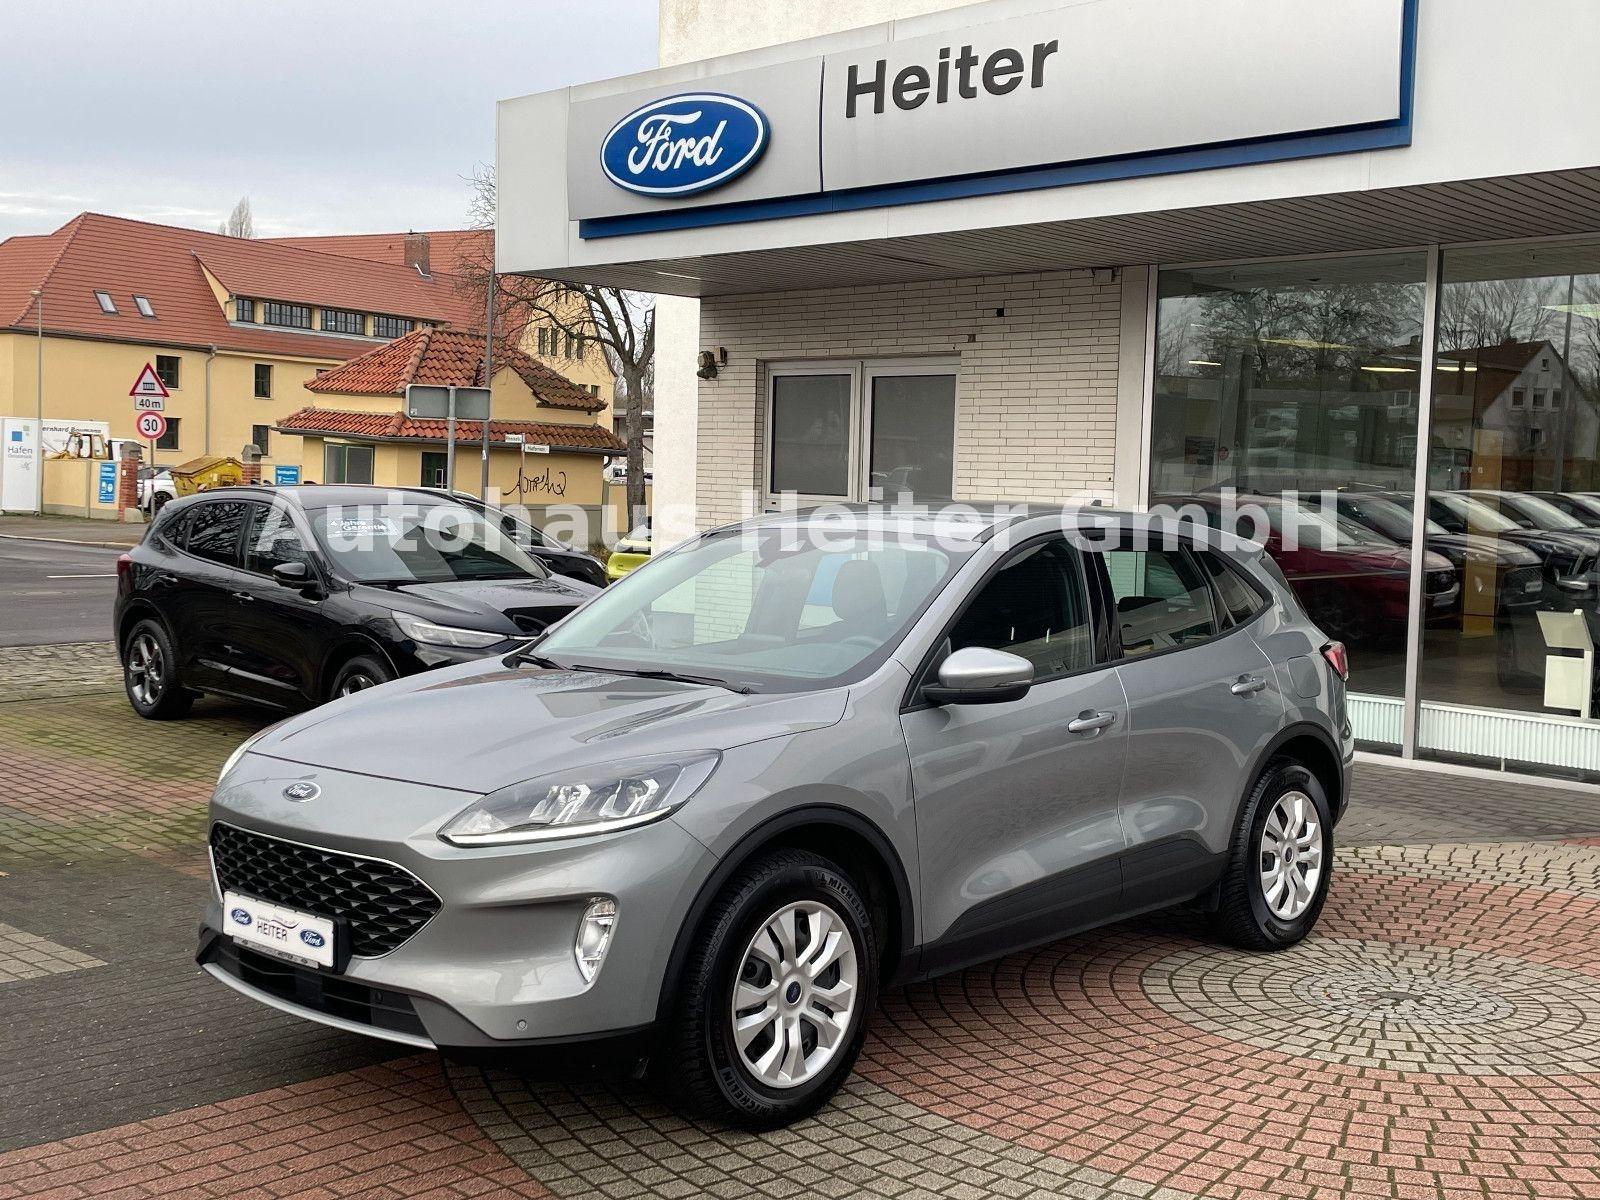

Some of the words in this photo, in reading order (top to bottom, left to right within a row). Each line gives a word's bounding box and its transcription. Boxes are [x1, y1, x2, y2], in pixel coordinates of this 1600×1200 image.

[845, 39, 1059, 119] Heiter
[627, 110, 724, 175] Ford
[143, 418, 158, 432] 30
[7, 446, 33, 455] Hafen
[257, 920, 288, 942] HEITER
